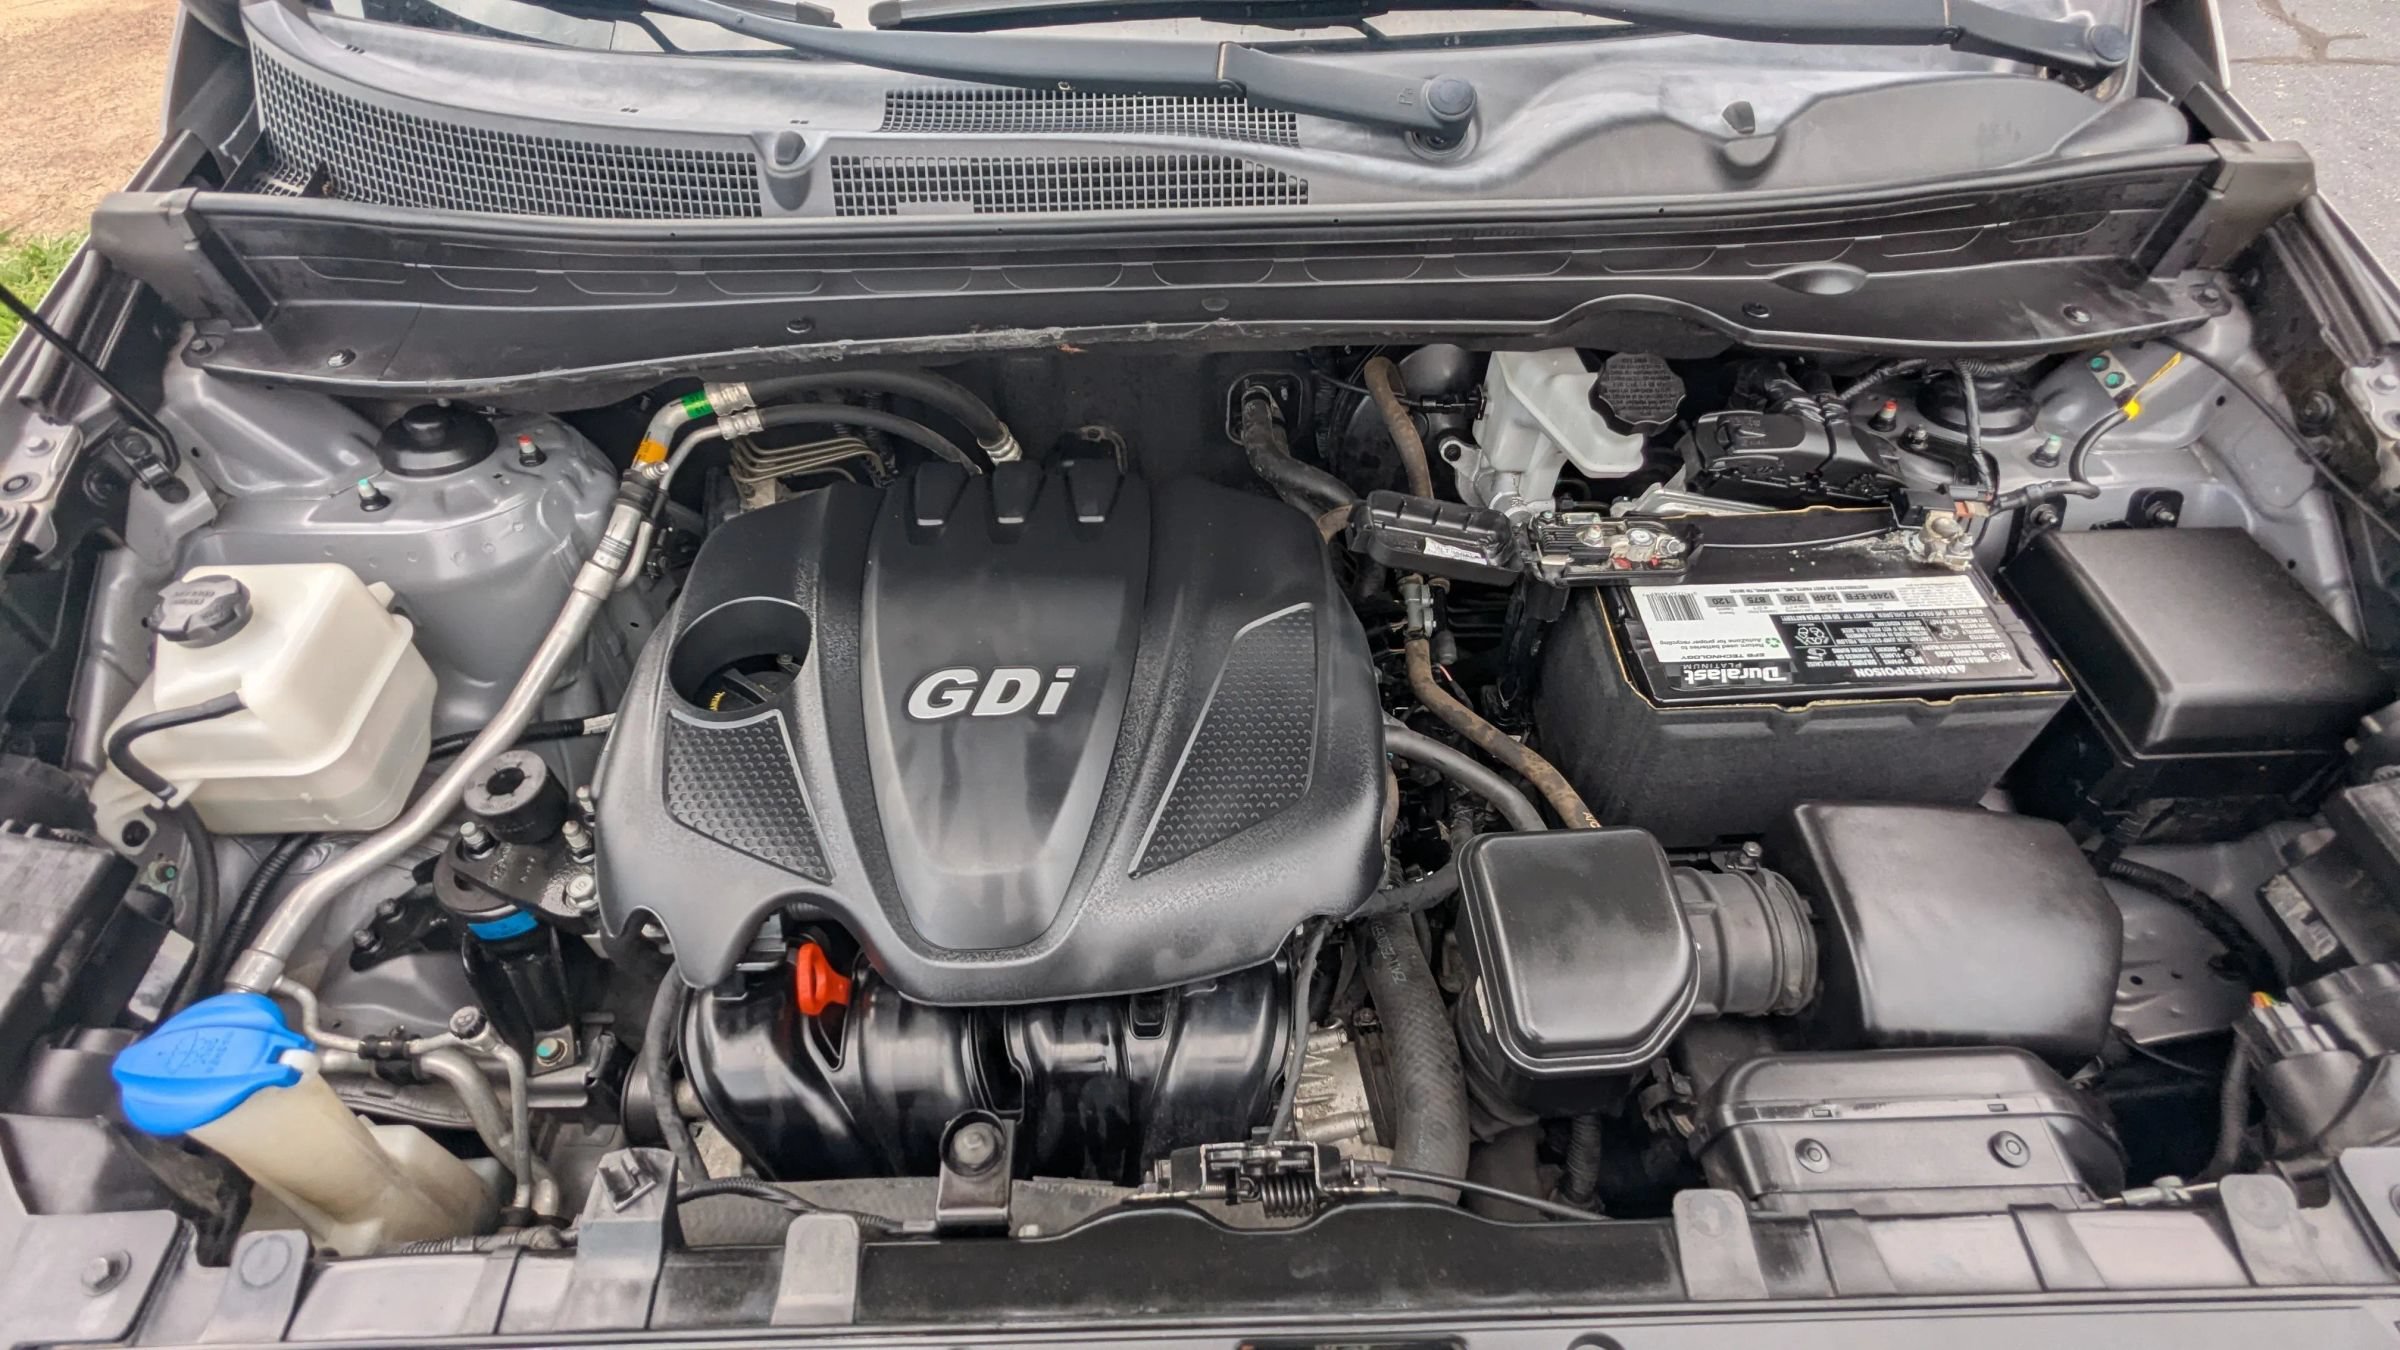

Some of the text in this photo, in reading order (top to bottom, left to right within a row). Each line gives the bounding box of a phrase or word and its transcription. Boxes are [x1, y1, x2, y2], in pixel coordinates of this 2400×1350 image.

[1813, 594, 1838, 602] 124R
[1845, 592, 1895, 601] 124R-EFB
[1682, 662, 1742, 670] PLATINUM
[1853, 665, 1958, 678] DANGER/POISON
[1683, 666, 1787, 685] Duralast
[907, 667, 1077, 720] GDi
